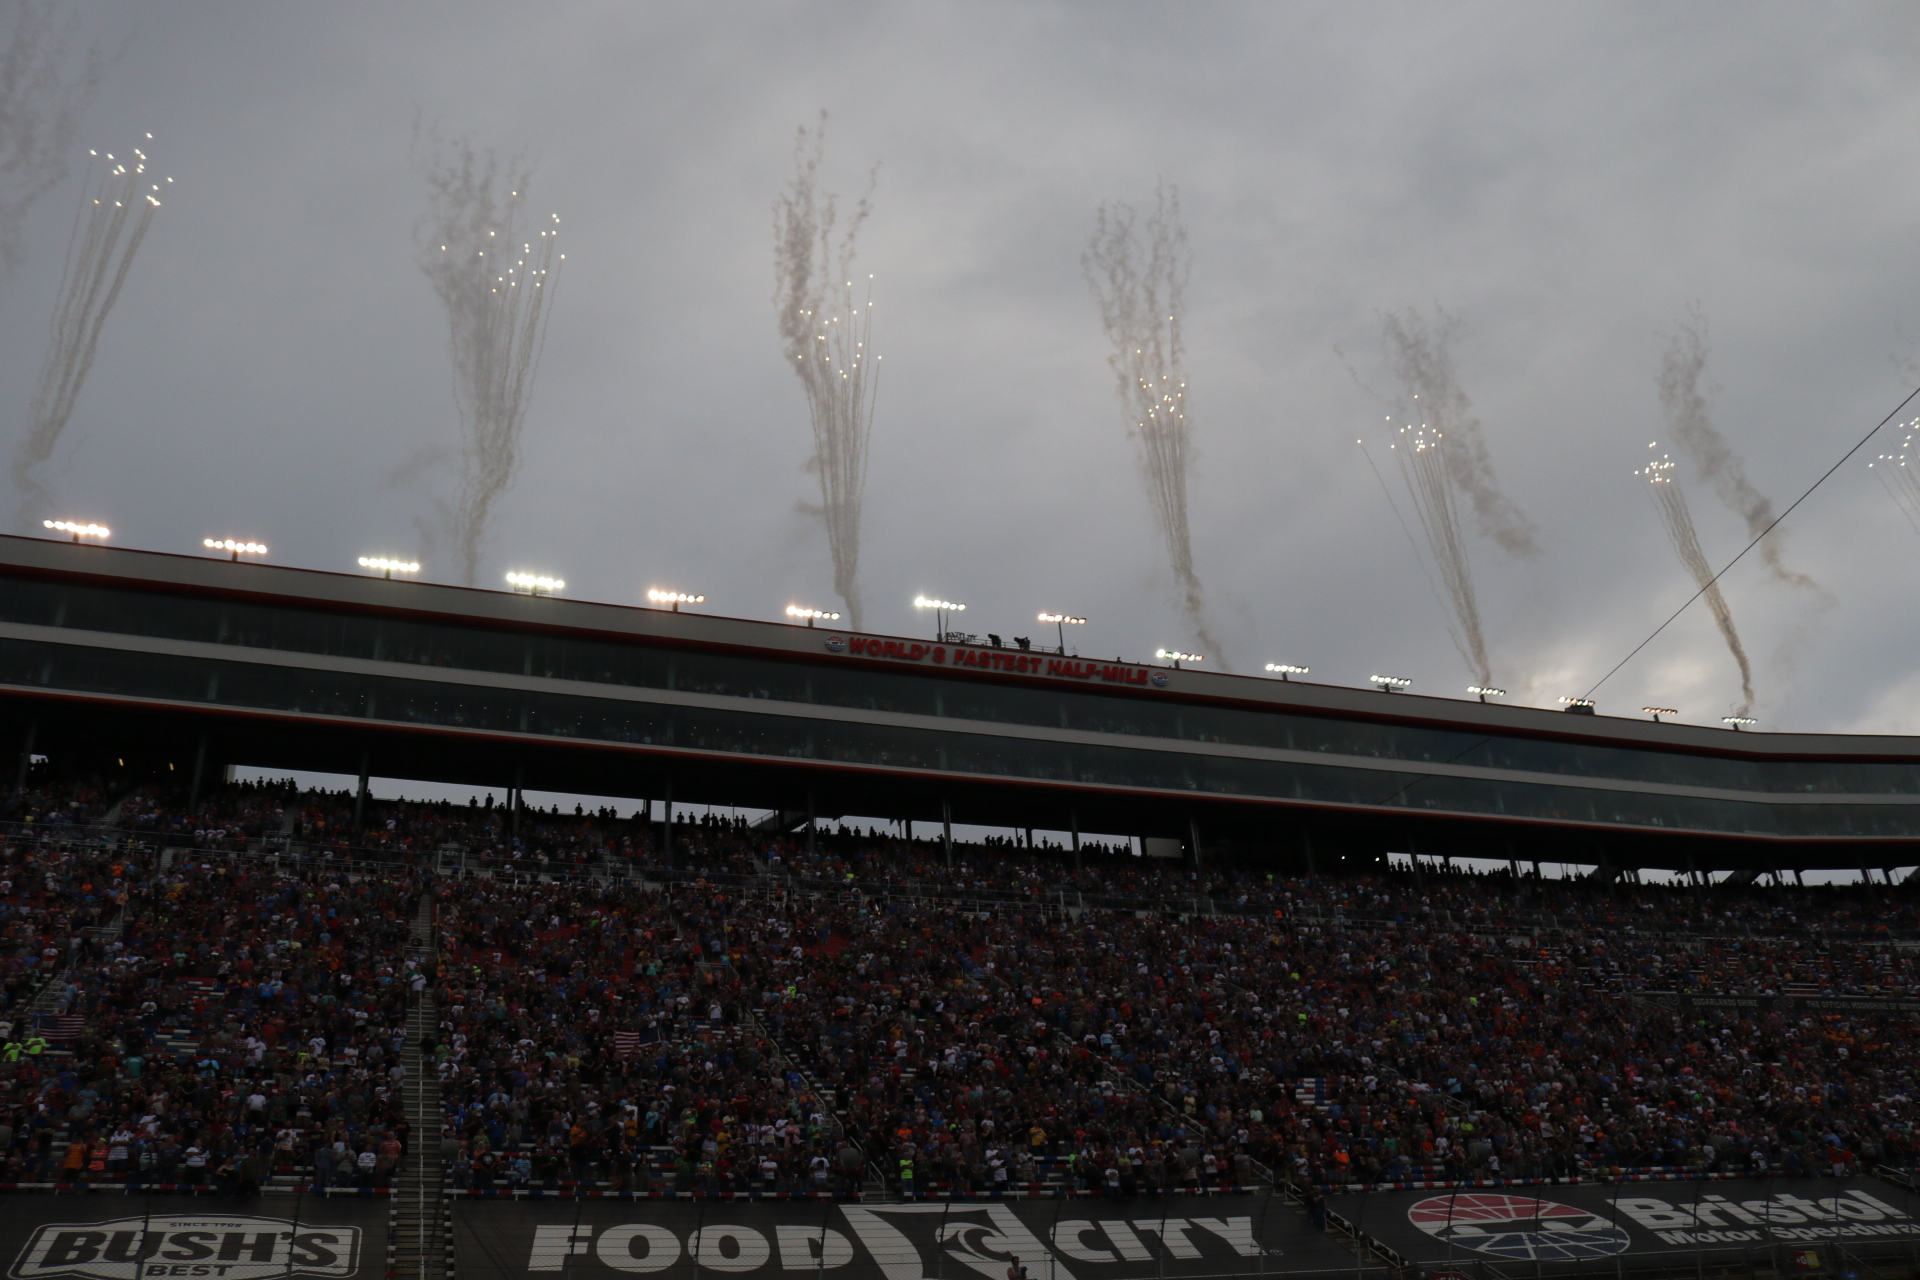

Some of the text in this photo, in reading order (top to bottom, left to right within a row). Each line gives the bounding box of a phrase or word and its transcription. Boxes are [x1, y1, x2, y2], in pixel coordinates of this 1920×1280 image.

[849, 637, 1148, 684] WORLD'S FASTEST HALF-MILE
[1692, 998, 1759, 1007] SUGARLANDS SHINE
[1806, 1000, 1821, 1008] THE
[1821, 1001, 1850, 1009] OFFICIAL
[1850, 1001, 1889, 1010] MOONSHINE
[1605, 1190, 1914, 1229] Bristol
[38, 1230, 339, 1268] BUSH'S
[528, 1223, 855, 1273] FOOD
[1050, 1216, 1268, 1263] CITY
[1654, 1222, 1920, 1244] Motor Speedwa
[145, 1265, 234, 1277] BEST
